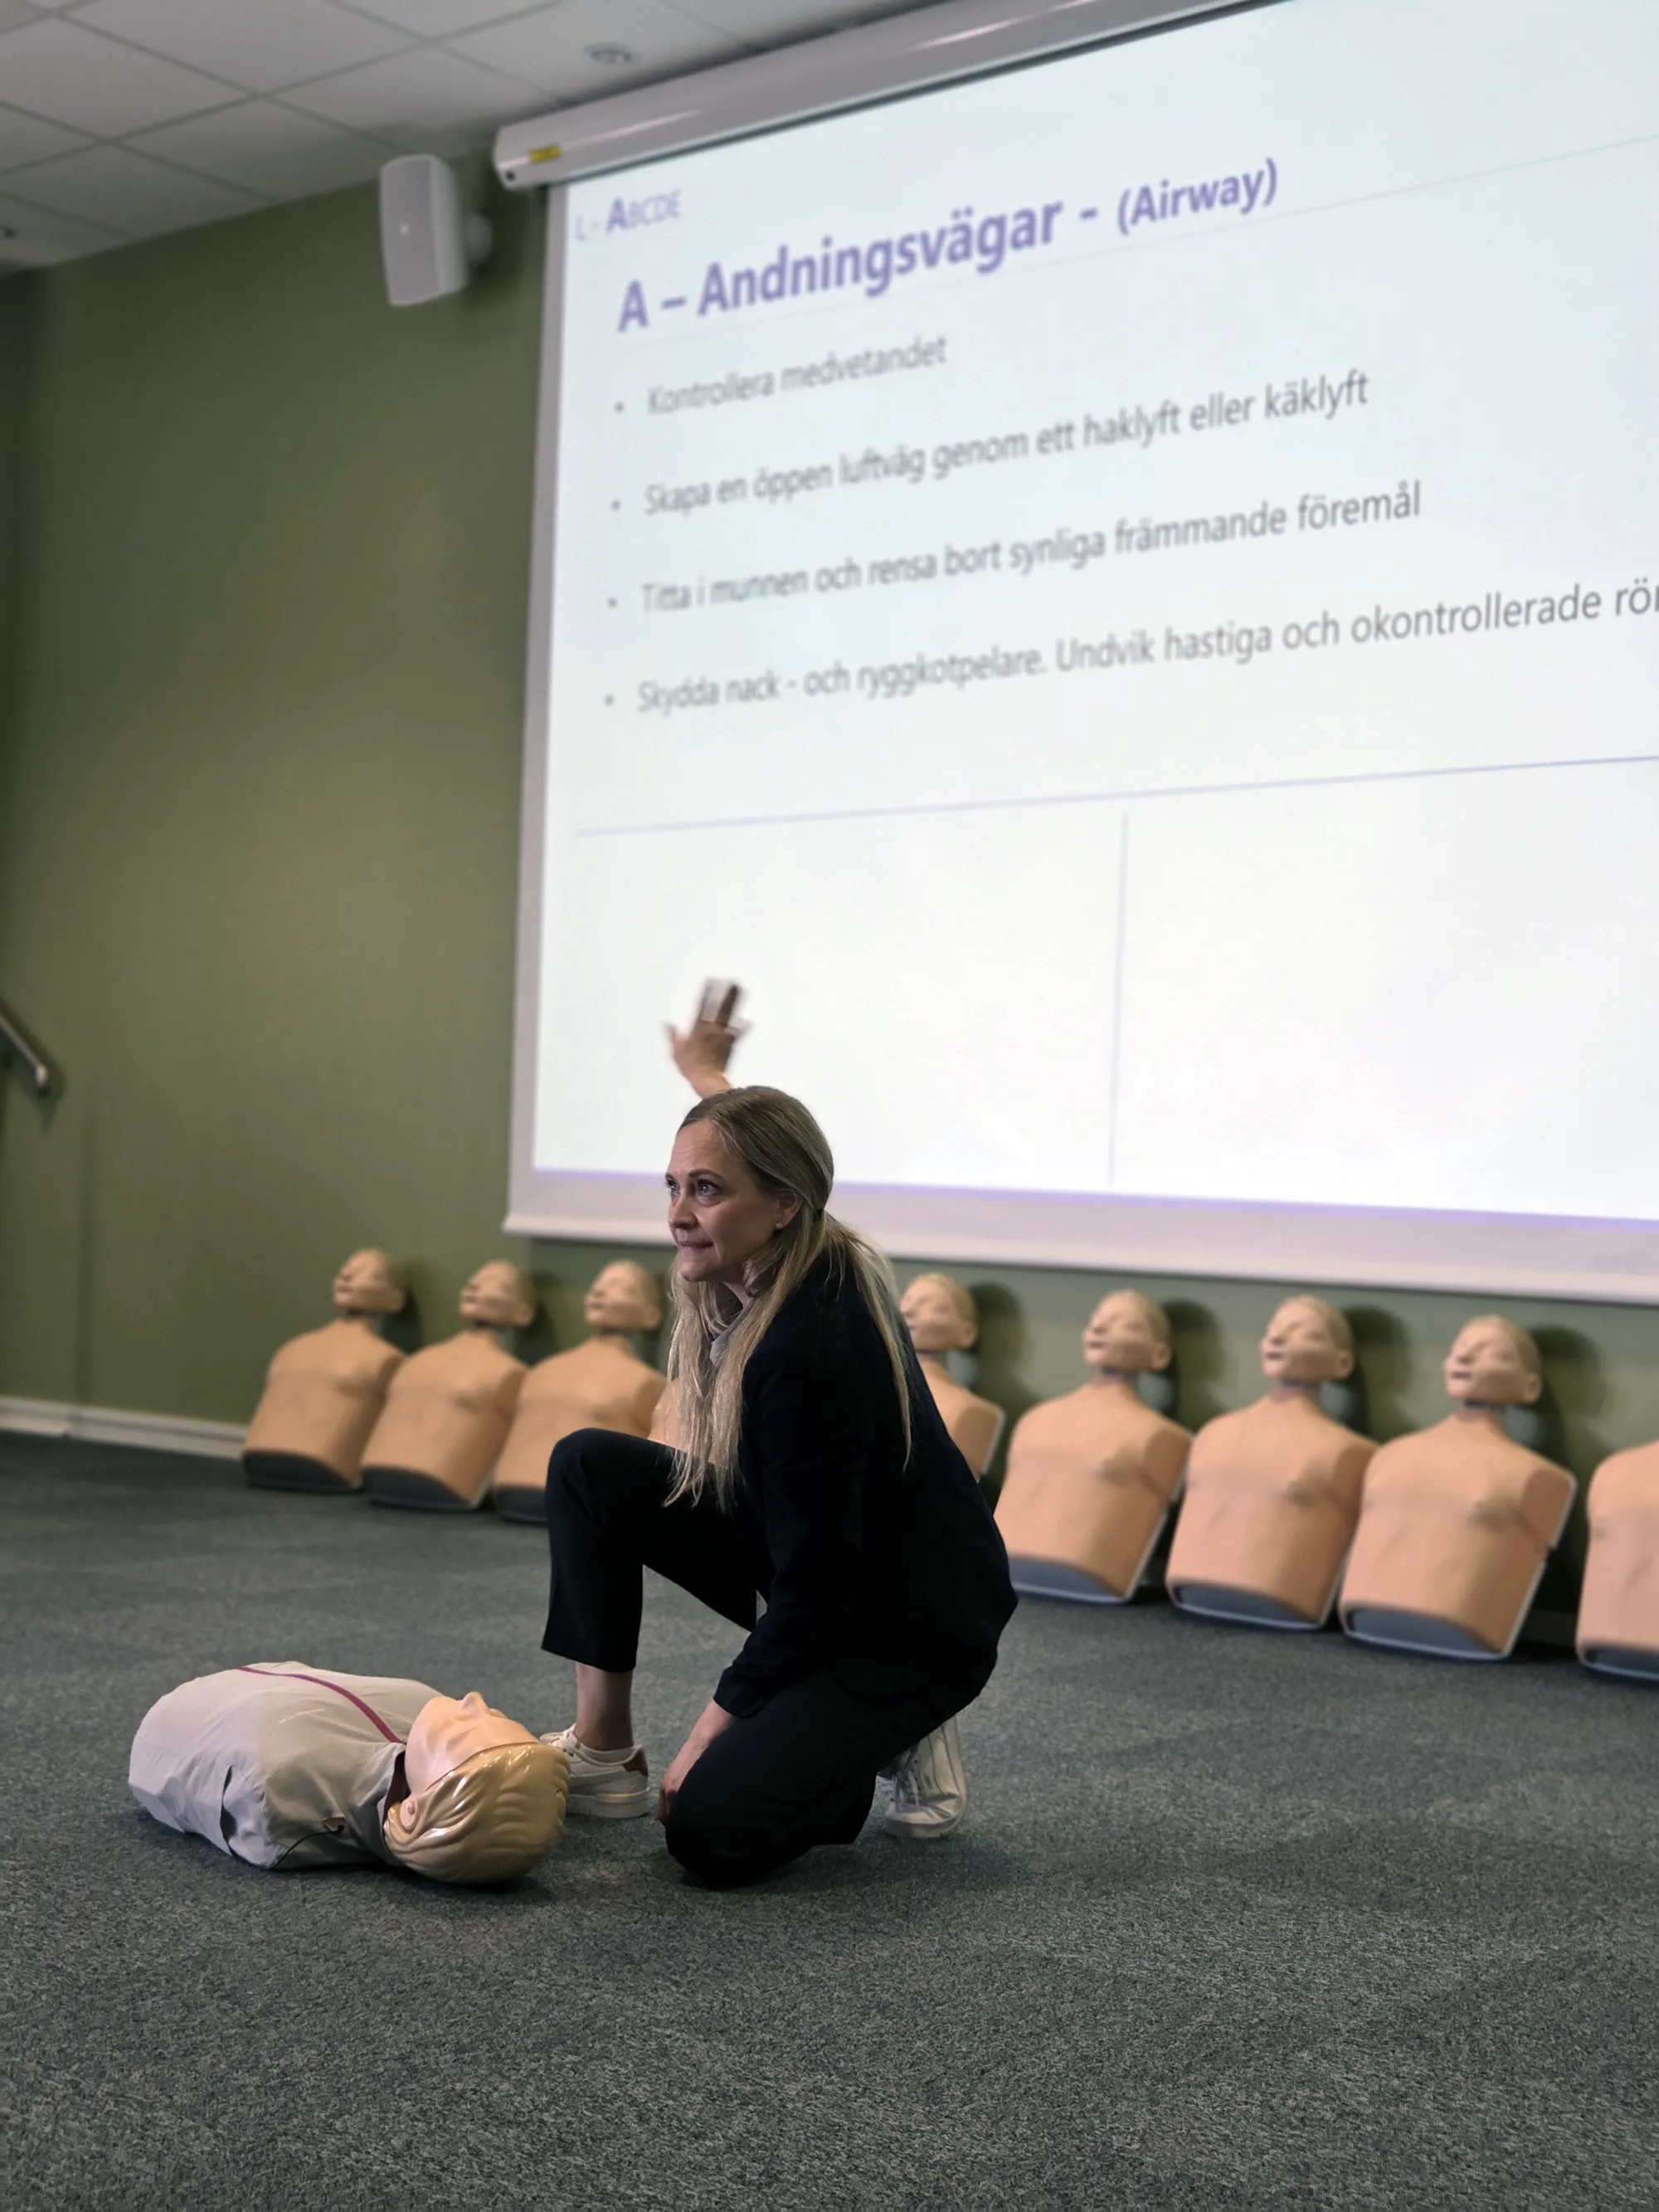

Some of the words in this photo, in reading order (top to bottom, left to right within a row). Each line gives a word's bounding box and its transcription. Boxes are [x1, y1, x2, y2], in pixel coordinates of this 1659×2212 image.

[617, 280, 649, 333] A
[698, 202, 1063, 317] Andningsvägar
[1117, 158, 1277, 235] (Airway)
[647, 367, 775, 415] Kontrollera
[781, 335, 946, 388] medvetandet
[644, 481, 711, 517] Skapa
[716, 476, 747, 503] en
[753, 465, 833, 503] öppen
[839, 445, 927, 484] luftväg
[932, 432, 1029, 480] genom
[1036, 421, 1076, 454] ett
[1082, 400, 1180, 448] haklyft
[1190, 393, 1255, 430] eller
[1264, 369, 1369, 420] käklyft
[642, 581, 692, 612] Titta
[697, 576, 705, 606] i
[710, 567, 809, 605] munnen
[815, 557, 863, 593] och
[868, 548, 937, 585] rensa
[943, 540, 1002, 576] bort
[1008, 526, 1106, 577] synliga
[1115, 500, 1287, 554] främmande
[1297, 479, 1421, 532] föremål
[637, 678, 720, 717] Skydda
[725, 668, 781, 702] nack
[803, 661, 852, 695] och
[857, 645, 1048, 699] ryggkotpelare.
[1055, 629, 1155, 670] Undvik
[1165, 620, 1272, 666] hastiga
[1282, 610, 1340, 650] och
[1350, 582, 1602, 644] okontrollerade
